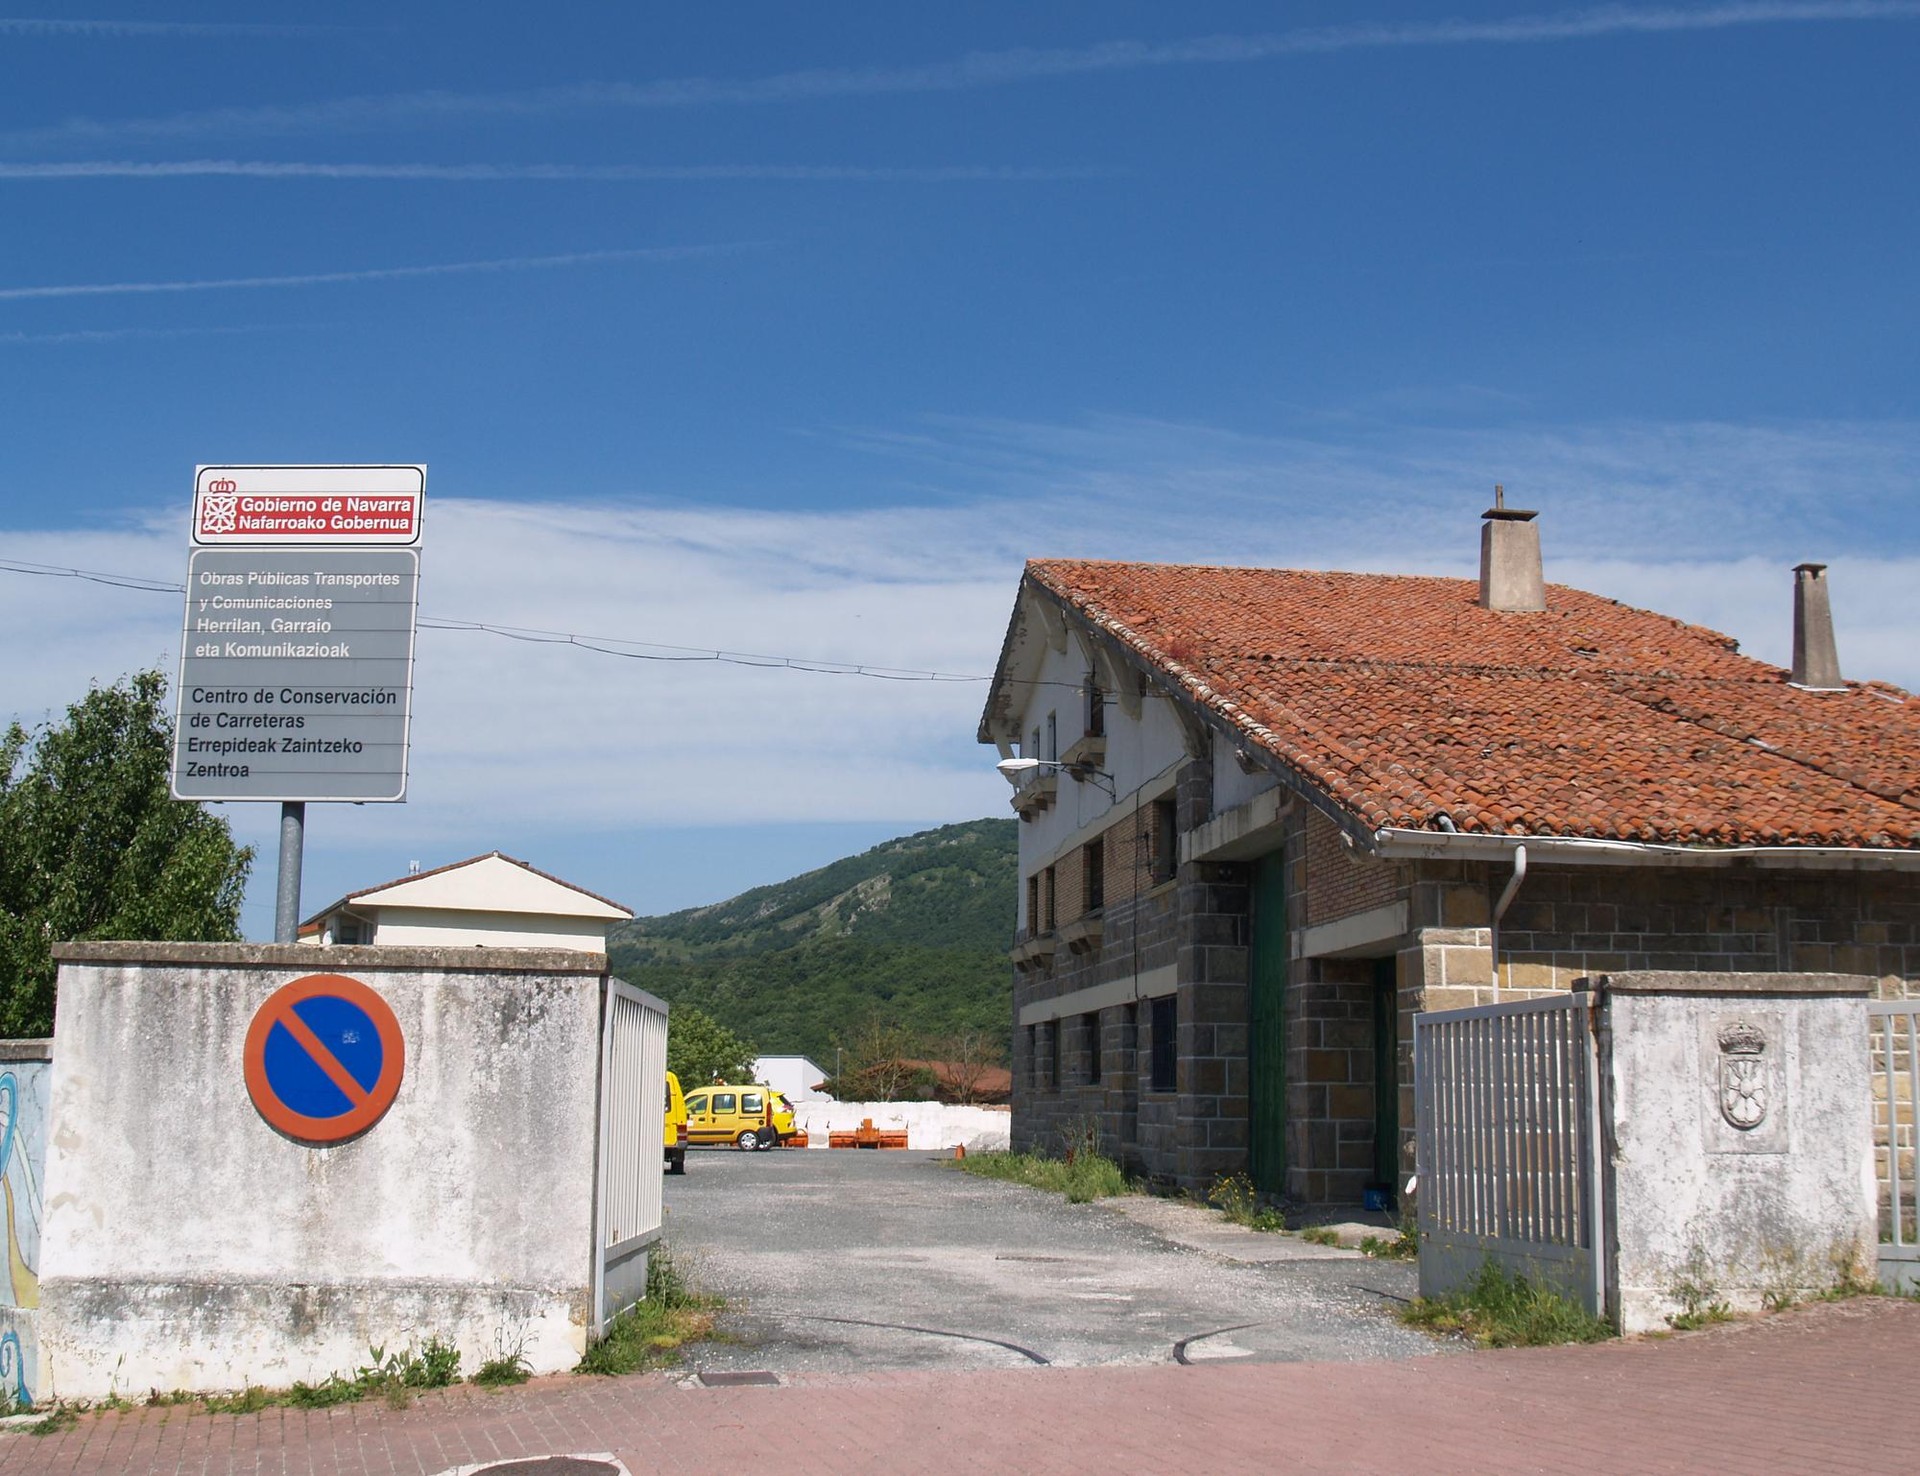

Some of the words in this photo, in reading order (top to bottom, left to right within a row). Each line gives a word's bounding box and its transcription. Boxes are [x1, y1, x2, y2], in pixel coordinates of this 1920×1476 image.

[241, 498, 317, 512] Gobierno
[321, 498, 341, 512] de
[346, 498, 411, 512] Navarra
[239, 516, 326, 530] Nafarroako
[330, 516, 409, 530] Gobernua
[200, 572, 243, 585] Obras
[248, 571, 309, 585] Públicas
[313, 572, 400, 588] Transportes
[199, 598, 208, 612] y
[212, 595, 332, 609] Comunicaciones
[197, 618, 265, 635] Herrilan,
[271, 618, 331, 633] Garraio
[195, 643, 219, 657] eta
[225, 642, 349, 657] Komunikazioak
[192, 688, 248, 704] Centro
[253, 688, 274, 704] de
[280, 687, 396, 704] Conservación
[190, 713, 210, 728] de
[216, 713, 305, 728] Carreteras
[188, 737, 276, 756] Errepideak
[281, 738, 363, 753] Zaintzeko
[186, 762, 249, 777] Zentroa
